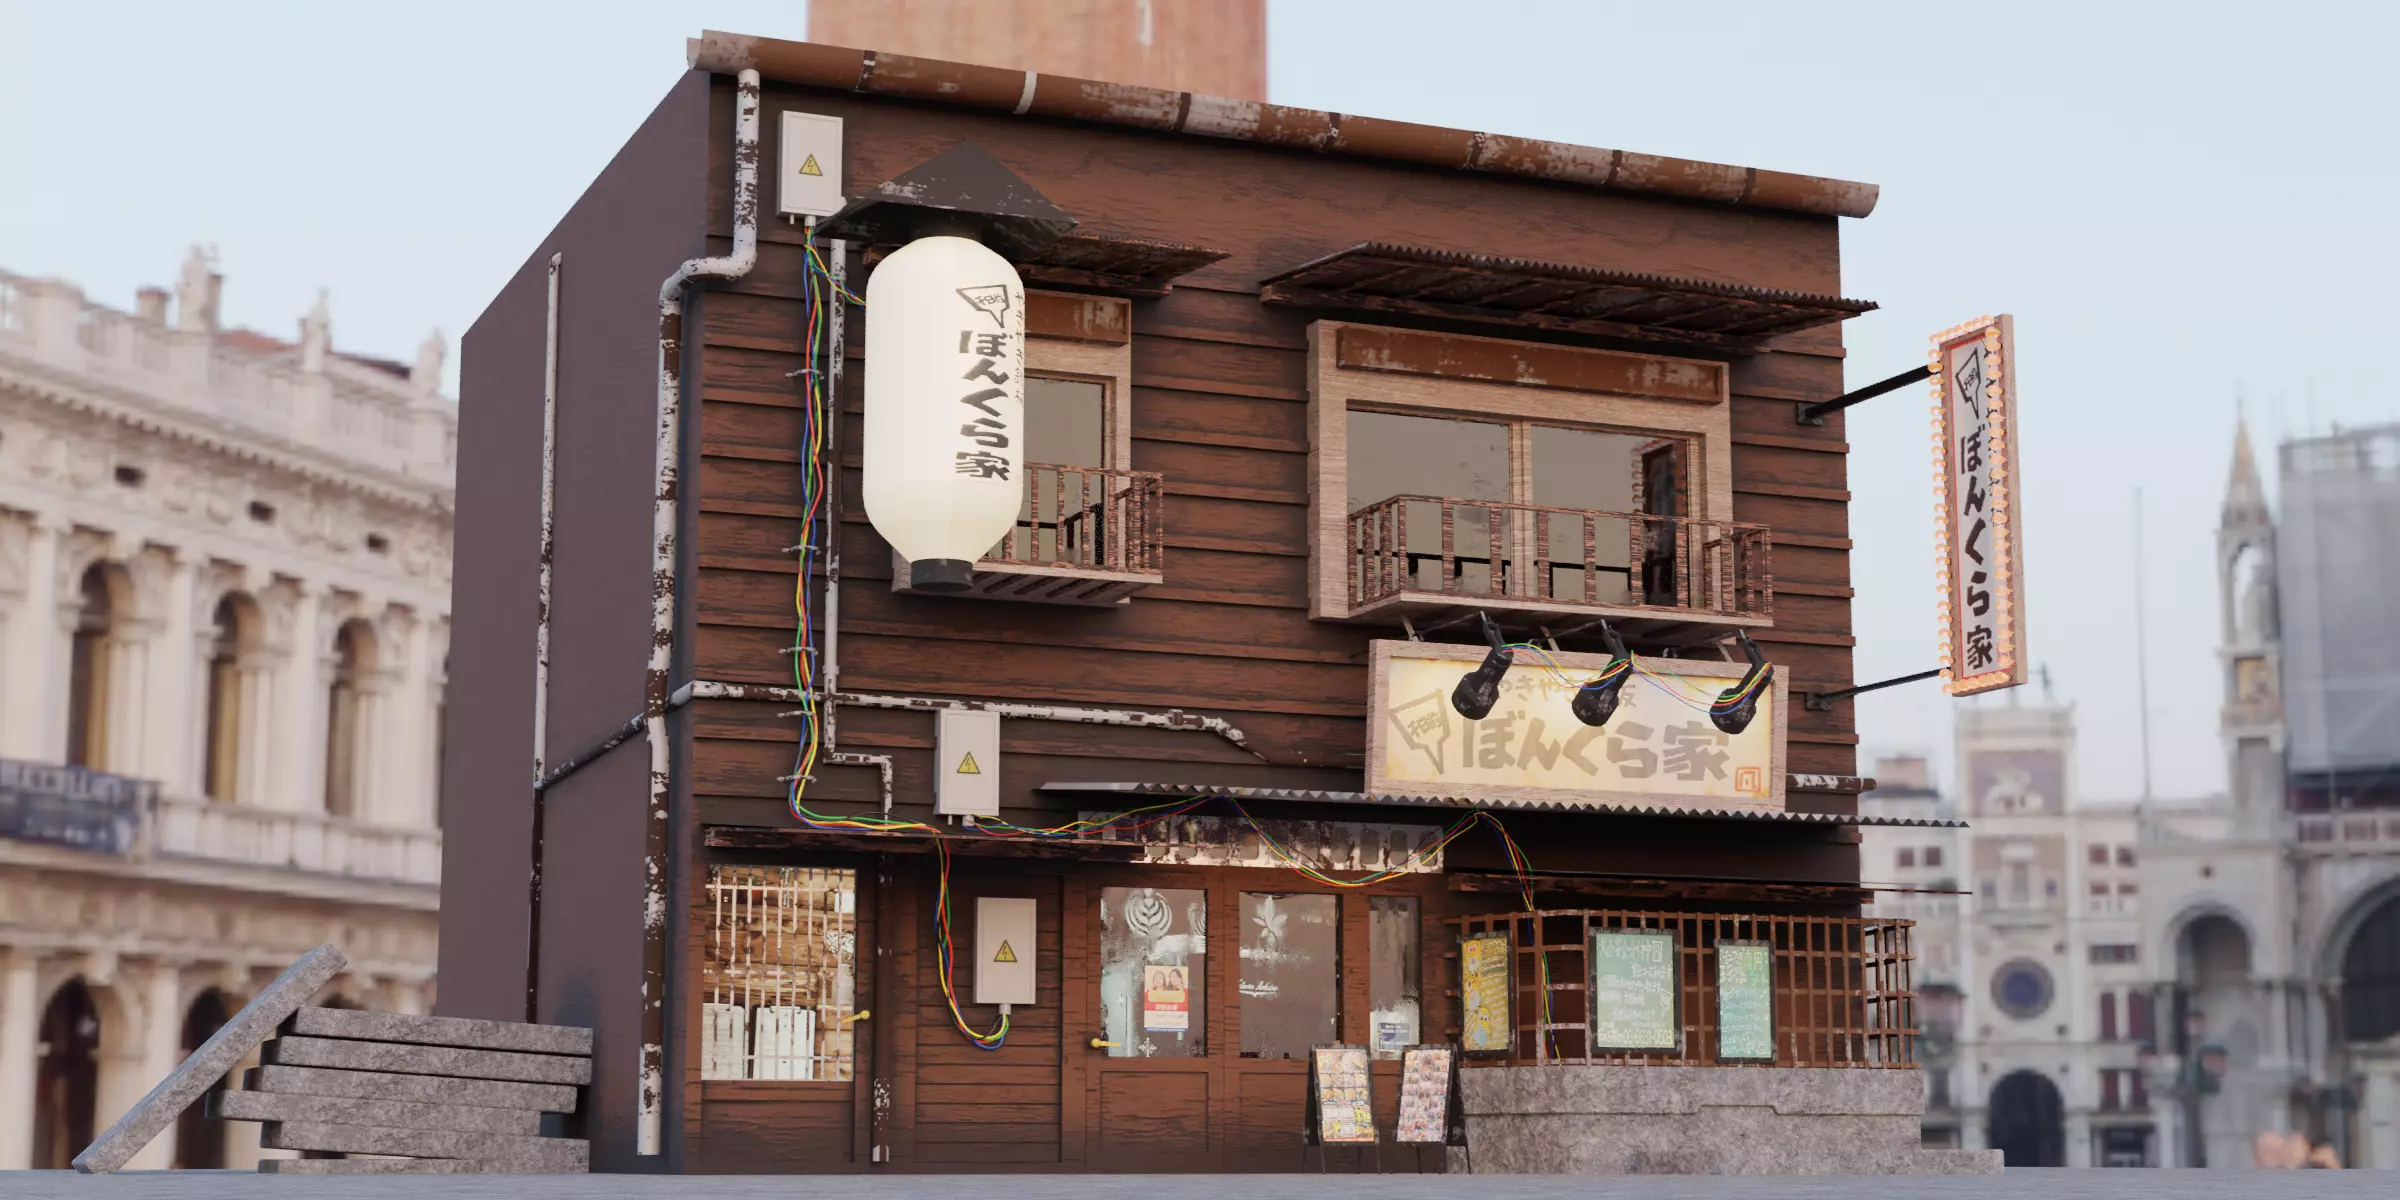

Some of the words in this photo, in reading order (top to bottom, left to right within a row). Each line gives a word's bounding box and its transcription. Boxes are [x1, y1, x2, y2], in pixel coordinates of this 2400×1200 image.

[956, 330, 1013, 482] ぼんくら家
[1960, 424, 1993, 671] ぼんくら家
[1462, 710, 1731, 782] ぼんくら家
